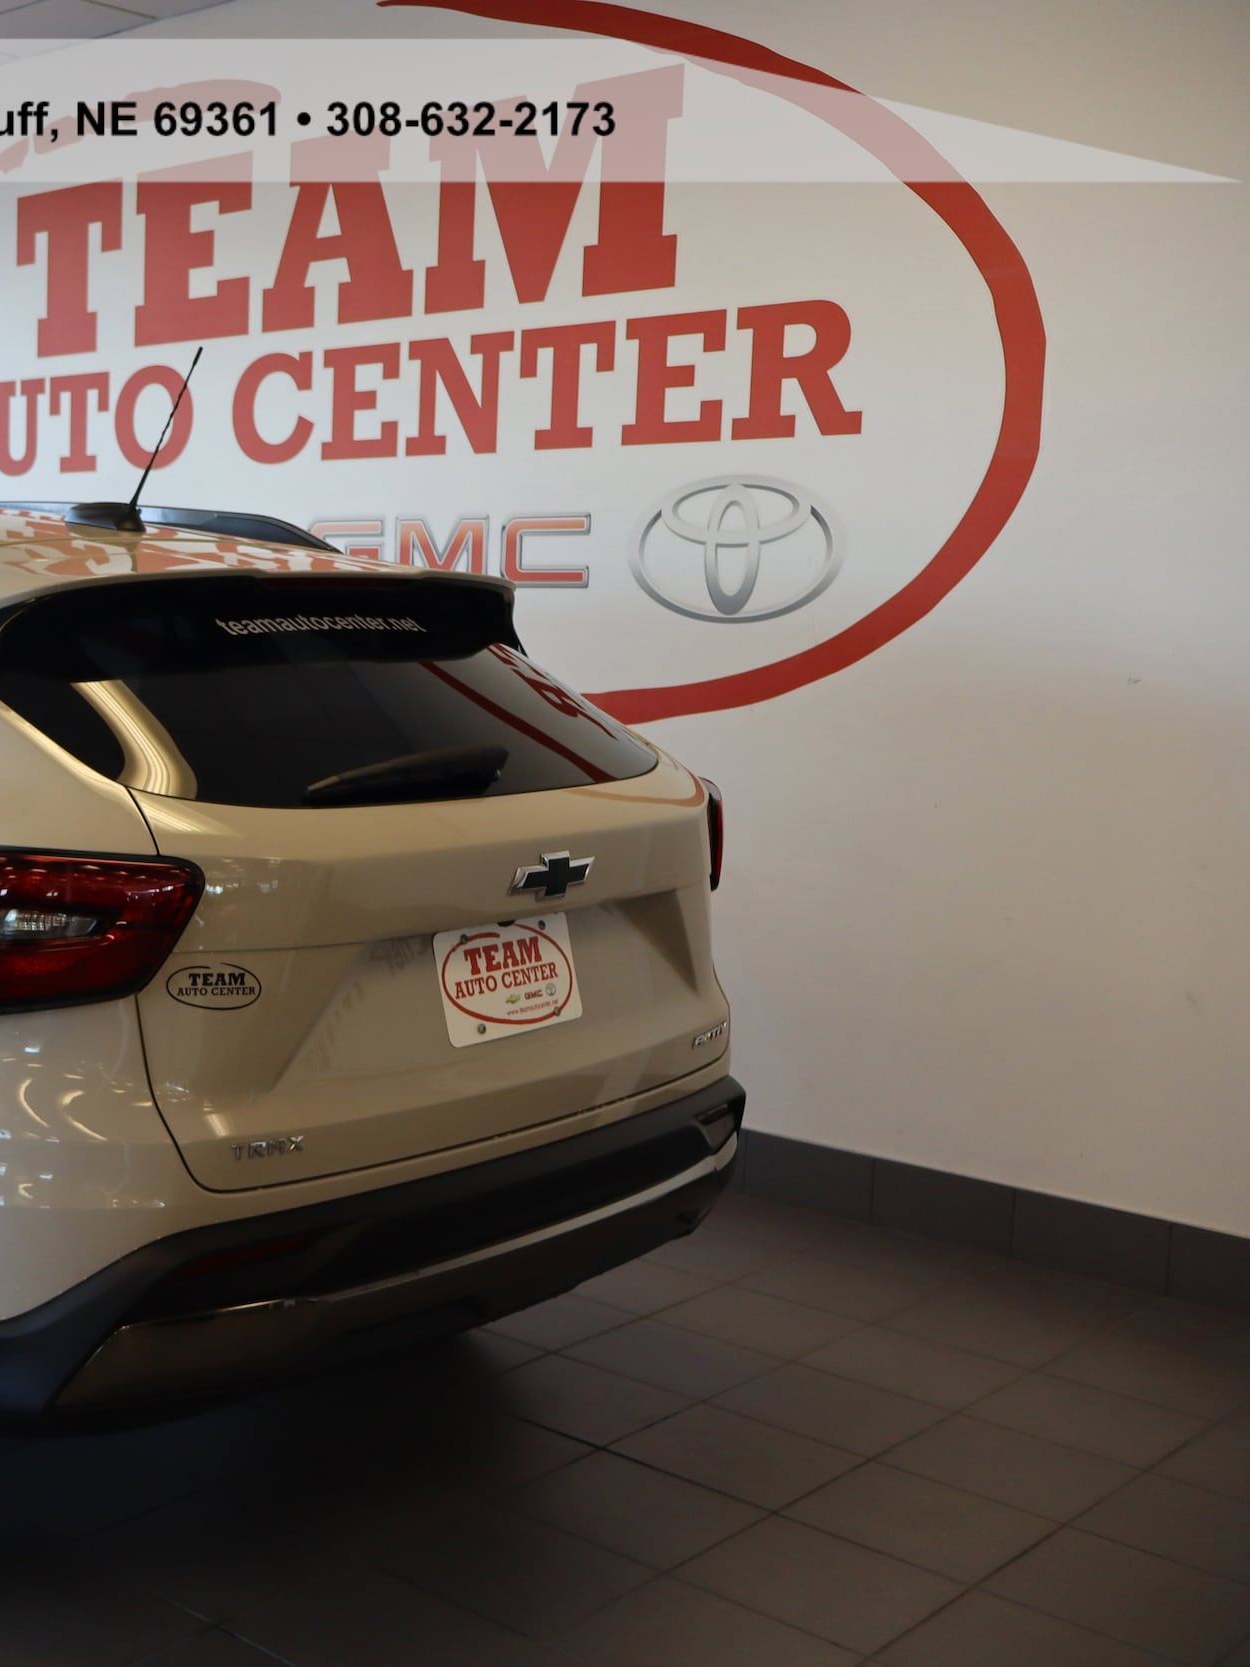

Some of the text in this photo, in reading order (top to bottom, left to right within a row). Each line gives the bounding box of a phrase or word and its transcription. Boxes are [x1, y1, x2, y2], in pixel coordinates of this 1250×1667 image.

[16, 63, 685, 358] TEAM
[231, 298, 863, 465] CENTER
[215, 613, 428, 636] teamautocenter.net
[463, 936, 543, 976] TEAM
[176, 986, 256, 997] AUTO CENTER
[188, 972, 246, 986] TEAM
[454, 961, 559, 1000] AUTO CENTER
